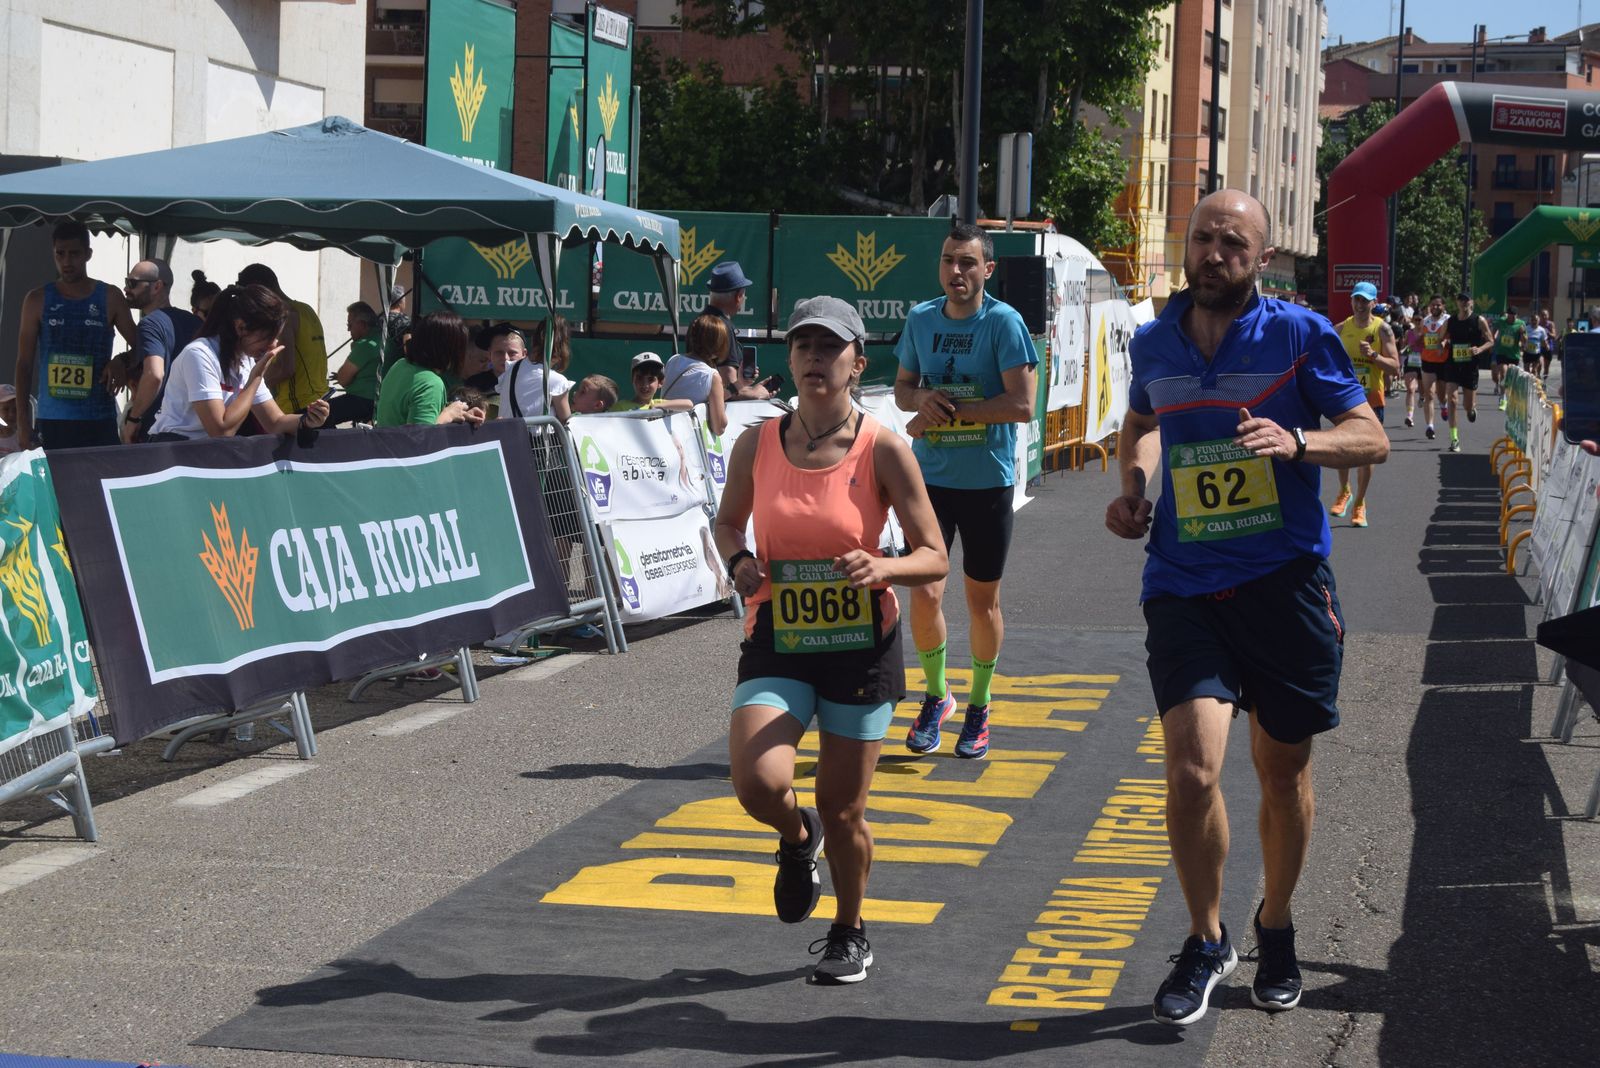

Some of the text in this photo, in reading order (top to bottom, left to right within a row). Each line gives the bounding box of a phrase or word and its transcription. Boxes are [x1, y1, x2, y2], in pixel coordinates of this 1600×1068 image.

[1509, 116, 1561, 129] ZAMORA
[605, 151, 627, 175] RURAL
[438, 284, 490, 306] CAJA
[613, 291, 754, 315] CAJA RUL
[932, 333, 943, 354] V
[943, 338, 974, 349] UFONES
[52, 366, 85, 385] 128
[958, 434, 983, 442] RURAL
[1196, 442, 1245, 455] FUNDAC
[1198, 449, 1256, 463] CAJA RURAL
[1196, 467, 1251, 509] 62
[1207, 512, 1276, 532] CAJA RURAL
[269, 508, 481, 613] CAJA RURAL
[799, 564, 833, 572] FUNDA
[644, 566, 665, 581] osea
[800, 571, 847, 581] CAJA RUR
[780, 586, 861, 624] 0968
[802, 632, 869, 646] CAJA RURAL
[985, 876, 1164, 1010] REFORMA
